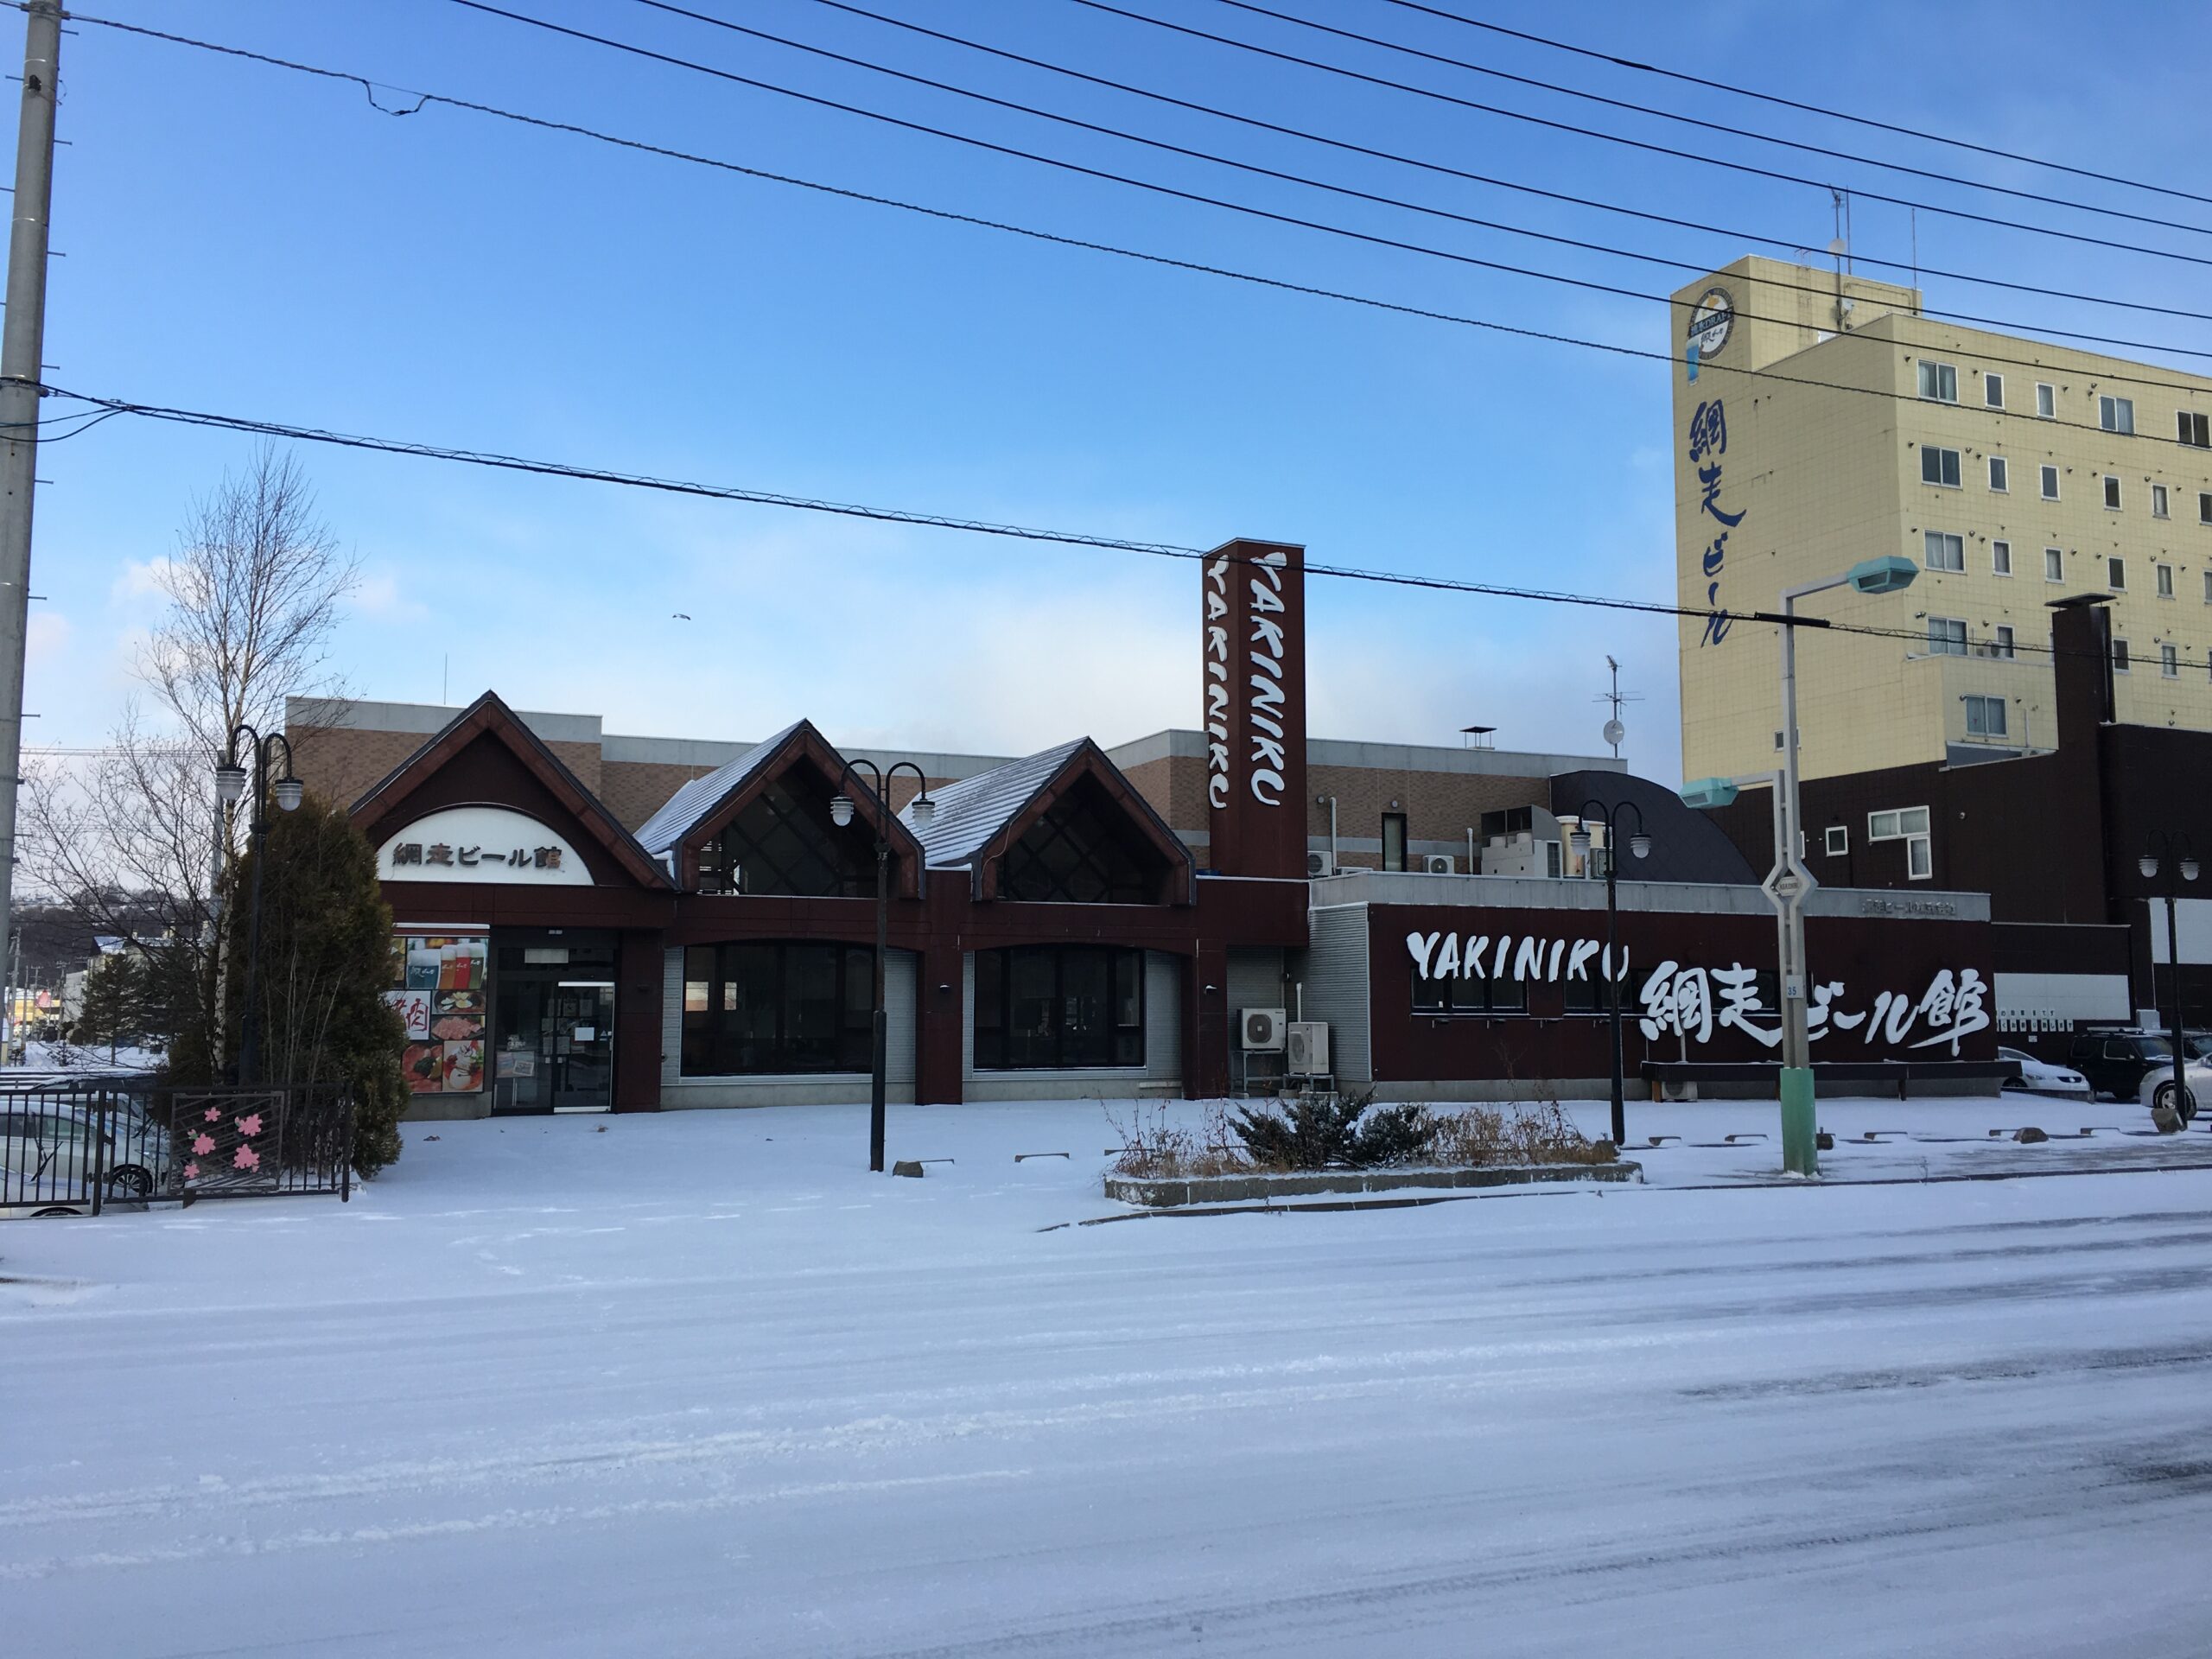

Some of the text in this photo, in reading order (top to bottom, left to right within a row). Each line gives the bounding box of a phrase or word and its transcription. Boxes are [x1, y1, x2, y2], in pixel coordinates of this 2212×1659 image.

[1207, 554, 1229, 809] YAKINIKU
[1249, 552, 1287, 805] YAKINIKU
[392, 842, 563, 868] 網走ビール館
[1406, 931, 1630, 982] YAKINIKU
[1788, 986, 1797, 996] 35
[1639, 960, 1990, 1057] 網走ビール館
